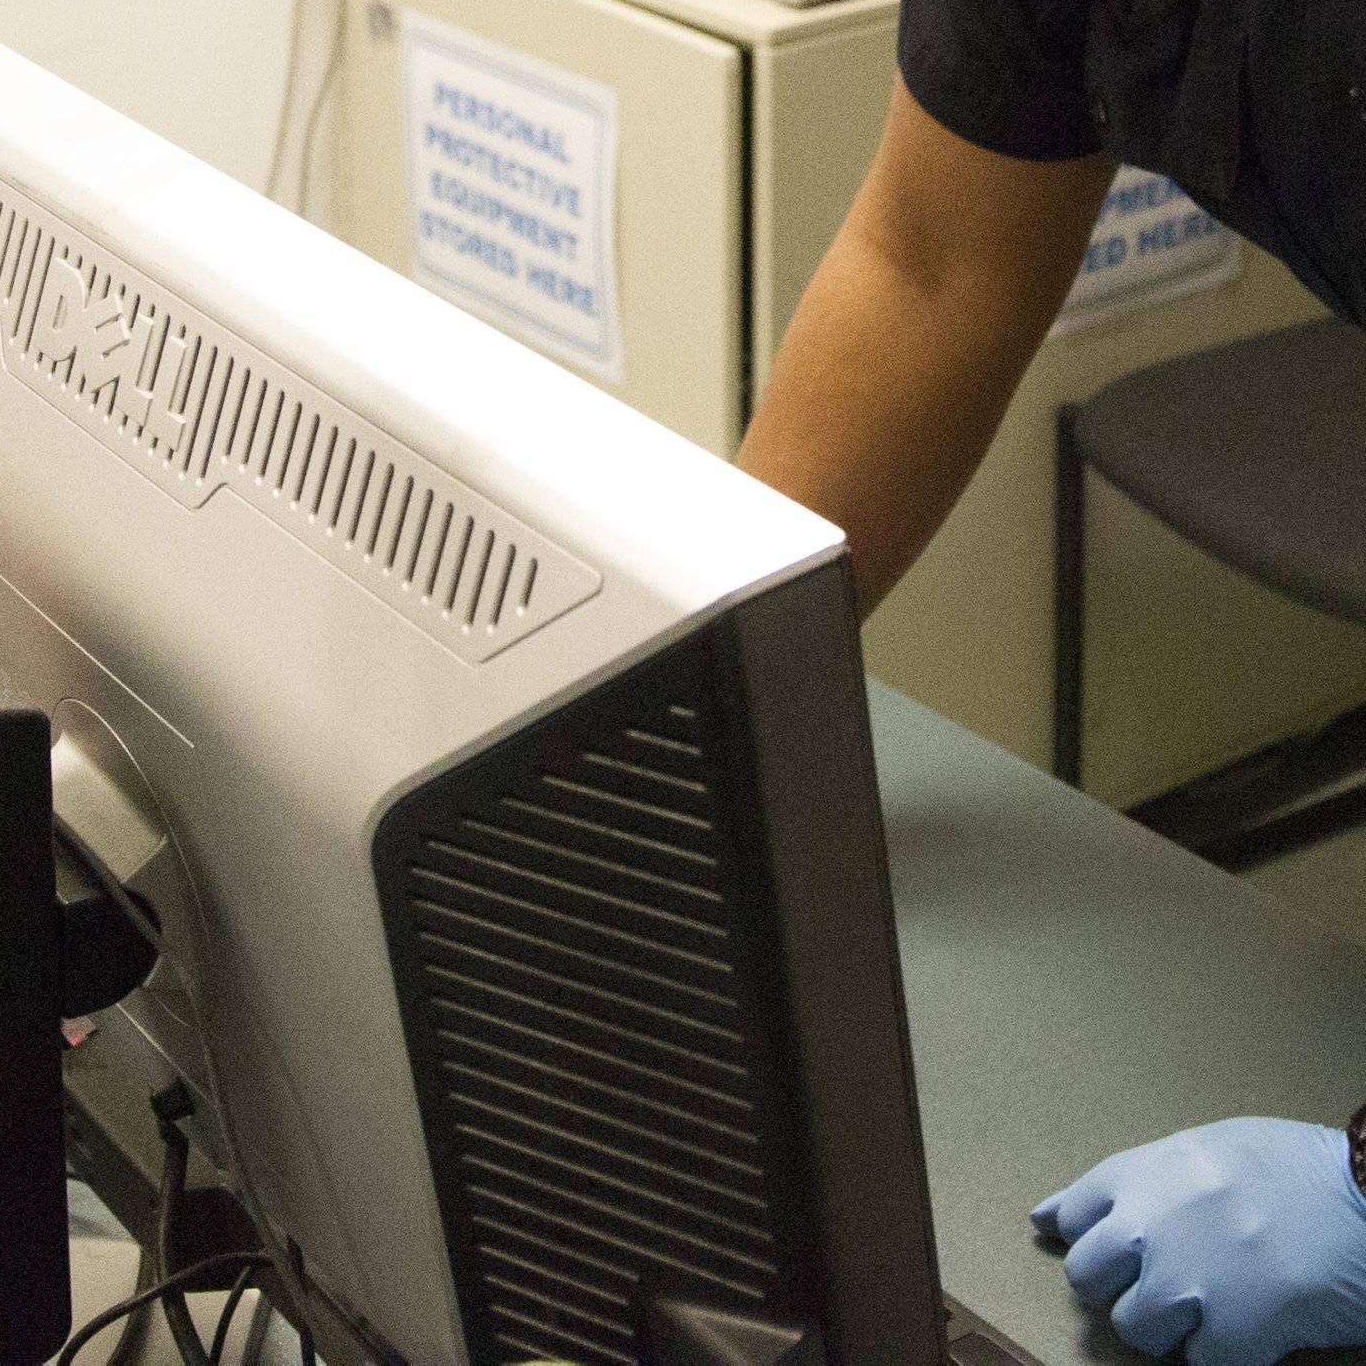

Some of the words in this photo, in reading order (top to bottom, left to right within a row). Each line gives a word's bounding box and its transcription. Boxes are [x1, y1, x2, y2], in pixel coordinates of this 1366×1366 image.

[425, 121, 581, 218] PROTECTIVE
[433, 83, 570, 164] PERSONAL
[430, 168, 579, 261] EQUIPMENT
[419, 209, 520, 278] STORED
[525, 260, 598, 316] HERE
